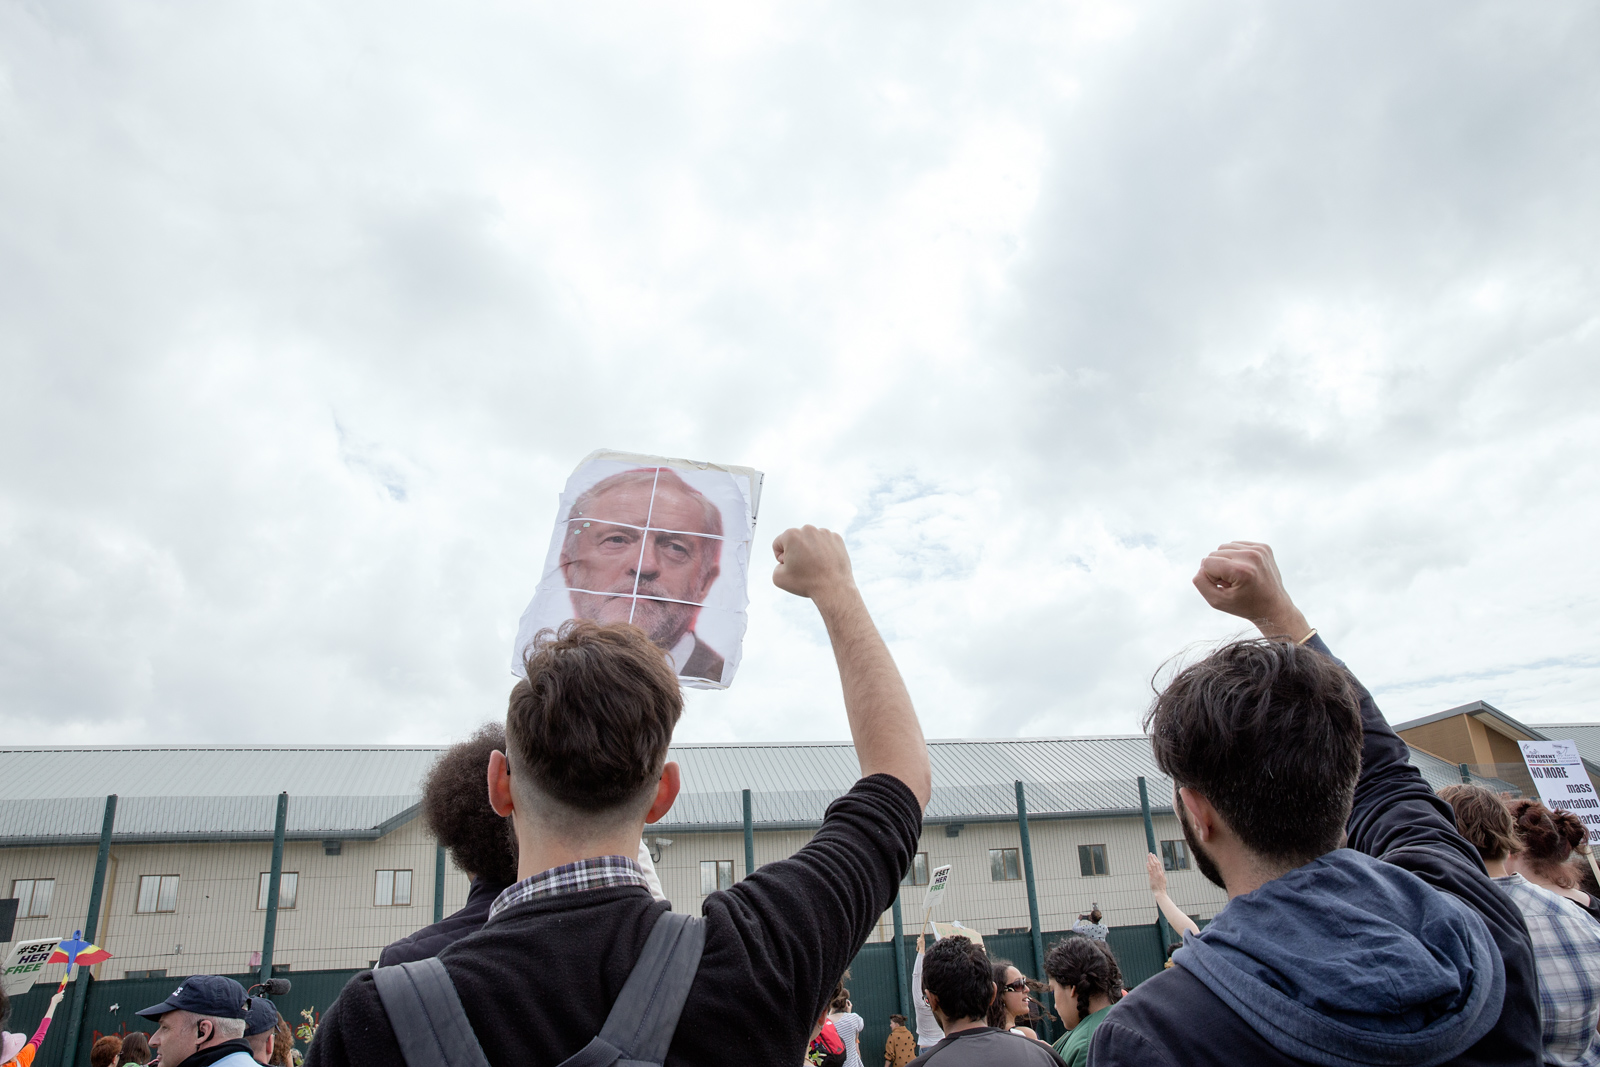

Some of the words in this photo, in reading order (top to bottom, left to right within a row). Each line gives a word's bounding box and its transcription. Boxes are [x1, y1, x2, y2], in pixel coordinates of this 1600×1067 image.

[1530, 767, 1543, 779] NO
[1543, 767, 1568, 778] MORE
[1566, 784, 1592, 793] mass
[1548, 798, 1599, 810] deportation
[934, 868, 950, 877] #SET
[935, 876, 947, 884] HER
[930, 883, 945, 892] FREE
[17, 942, 57, 955] #SET
[18, 953, 50, 964] HER
[4, 962, 43, 976] FREE
